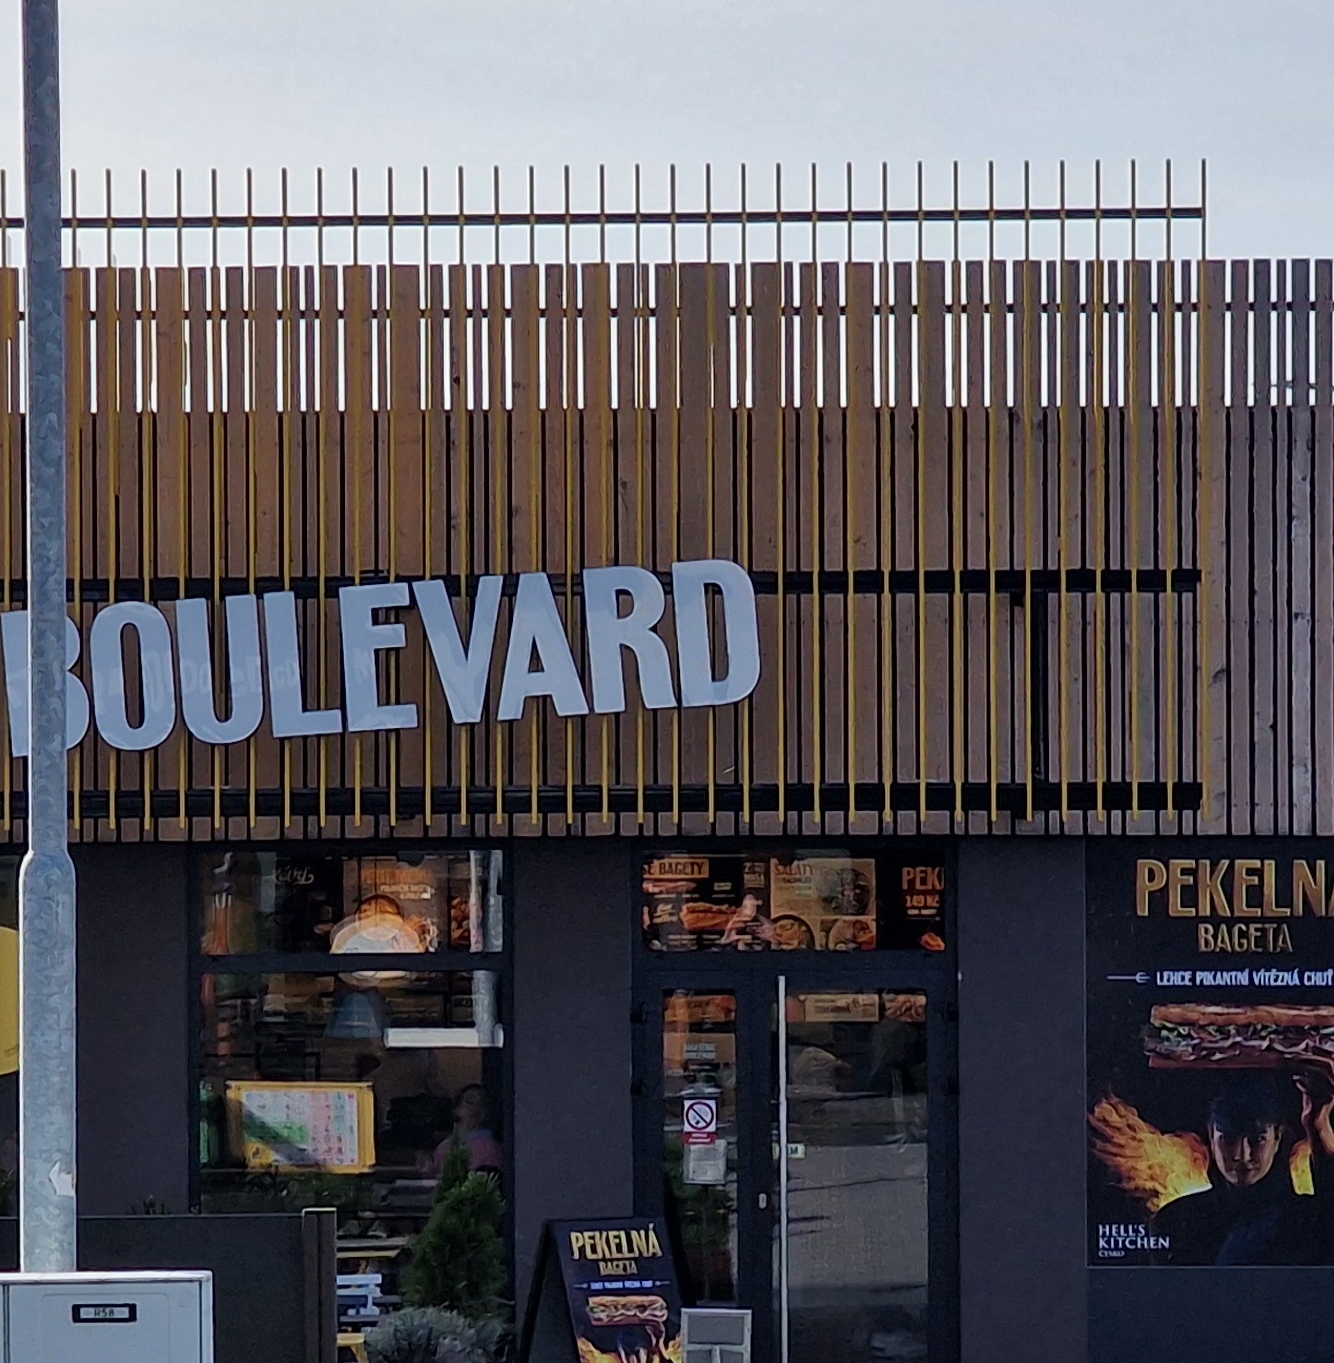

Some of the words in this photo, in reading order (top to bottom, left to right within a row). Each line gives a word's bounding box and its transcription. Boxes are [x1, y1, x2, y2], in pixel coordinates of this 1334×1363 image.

[0, 559, 761, 759] BOULEVARD
[659, 861, 704, 875] BAGETY
[1197, 923, 1294, 953] BAGETA
[570, 1222, 663, 1260] PEKELNÁ
[1098, 1224, 1146, 1236] HELL'S
[1098, 1236, 1170, 1249] KITCHEN
